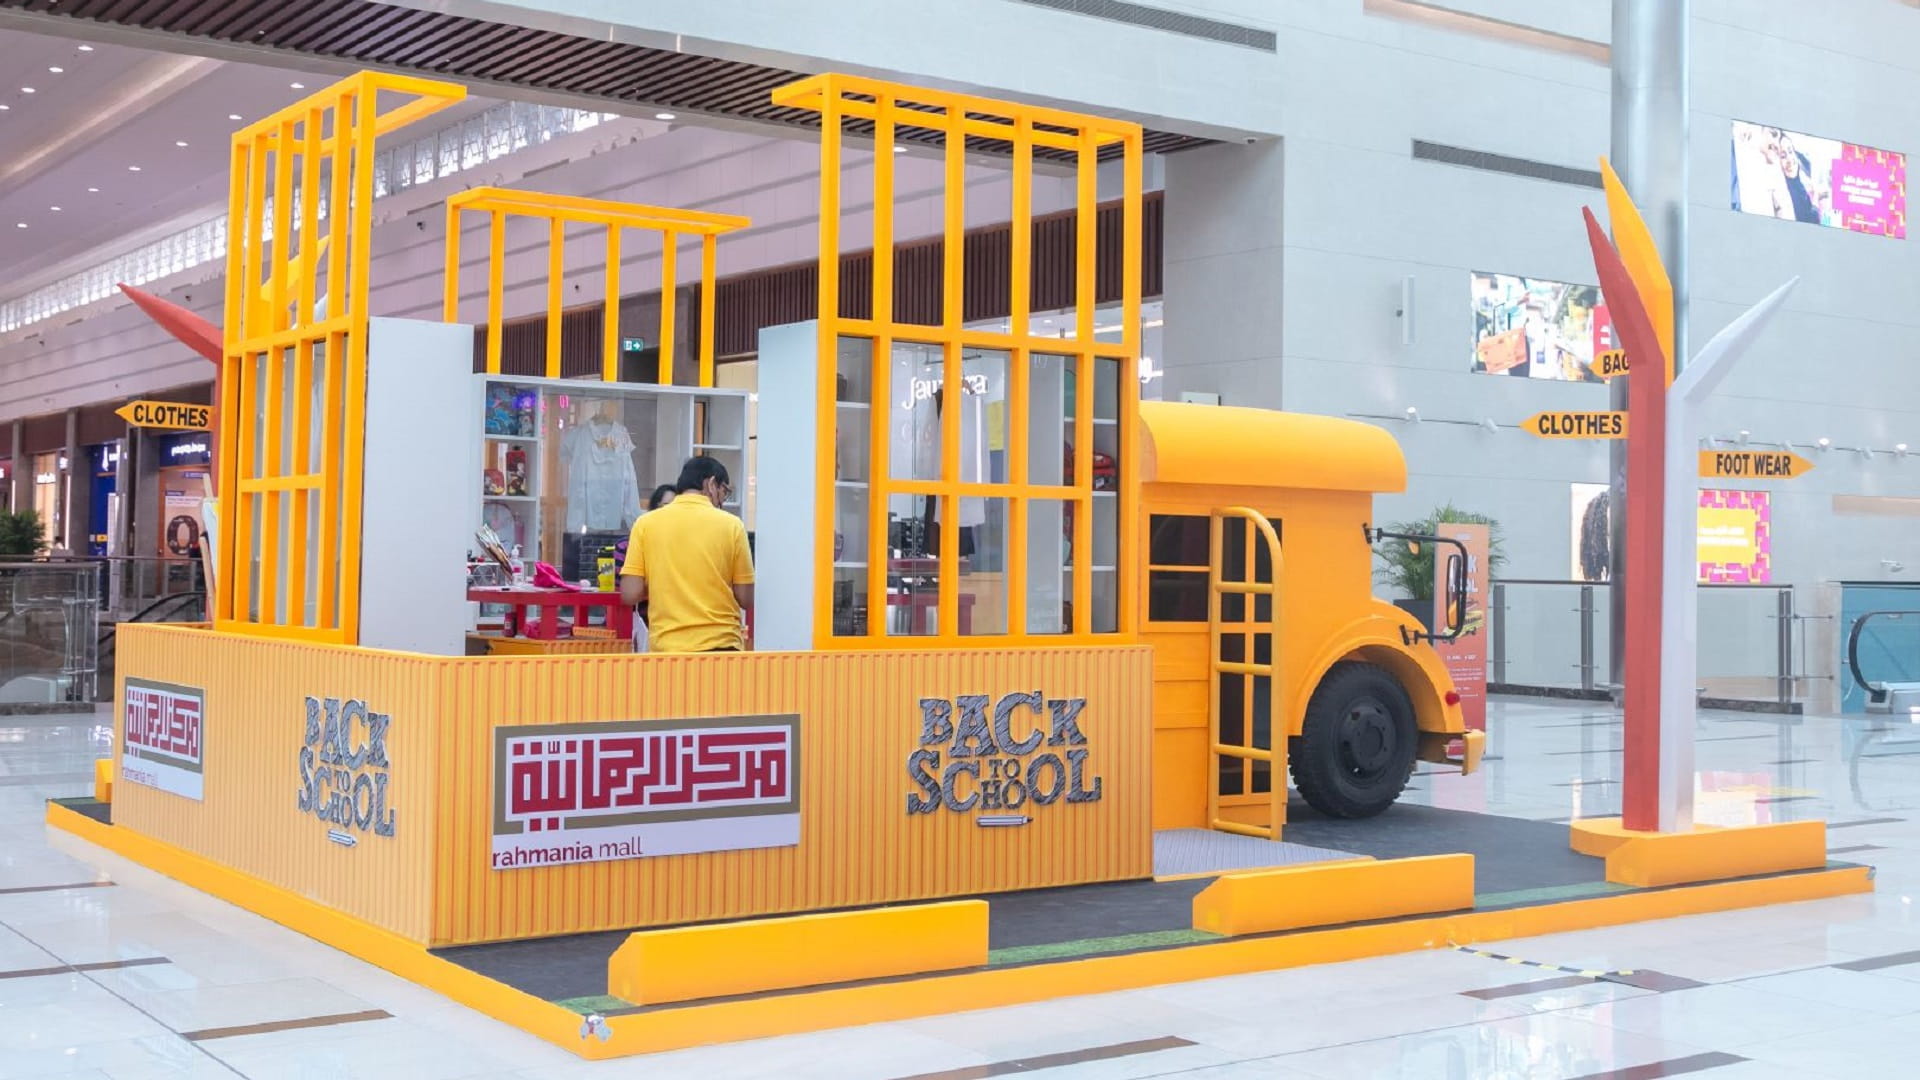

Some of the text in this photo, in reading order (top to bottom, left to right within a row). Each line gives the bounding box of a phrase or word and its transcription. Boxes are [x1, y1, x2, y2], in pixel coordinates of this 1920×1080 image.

[133, 404, 208, 428] CLOTHES
[1538, 414, 1622, 435] CLOTHES
[1716, 453, 1791, 476] FOOT WEAR
[305, 696, 391, 771] BACK
[919, 691, 1088, 758] BACK
[334, 769, 351, 792] TO
[907, 748, 1102, 815] SCHOOL
[988, 758, 1021, 779] TO
[298, 745, 396, 837] SCHOOL
[492, 836, 644, 867] rahmania mall
